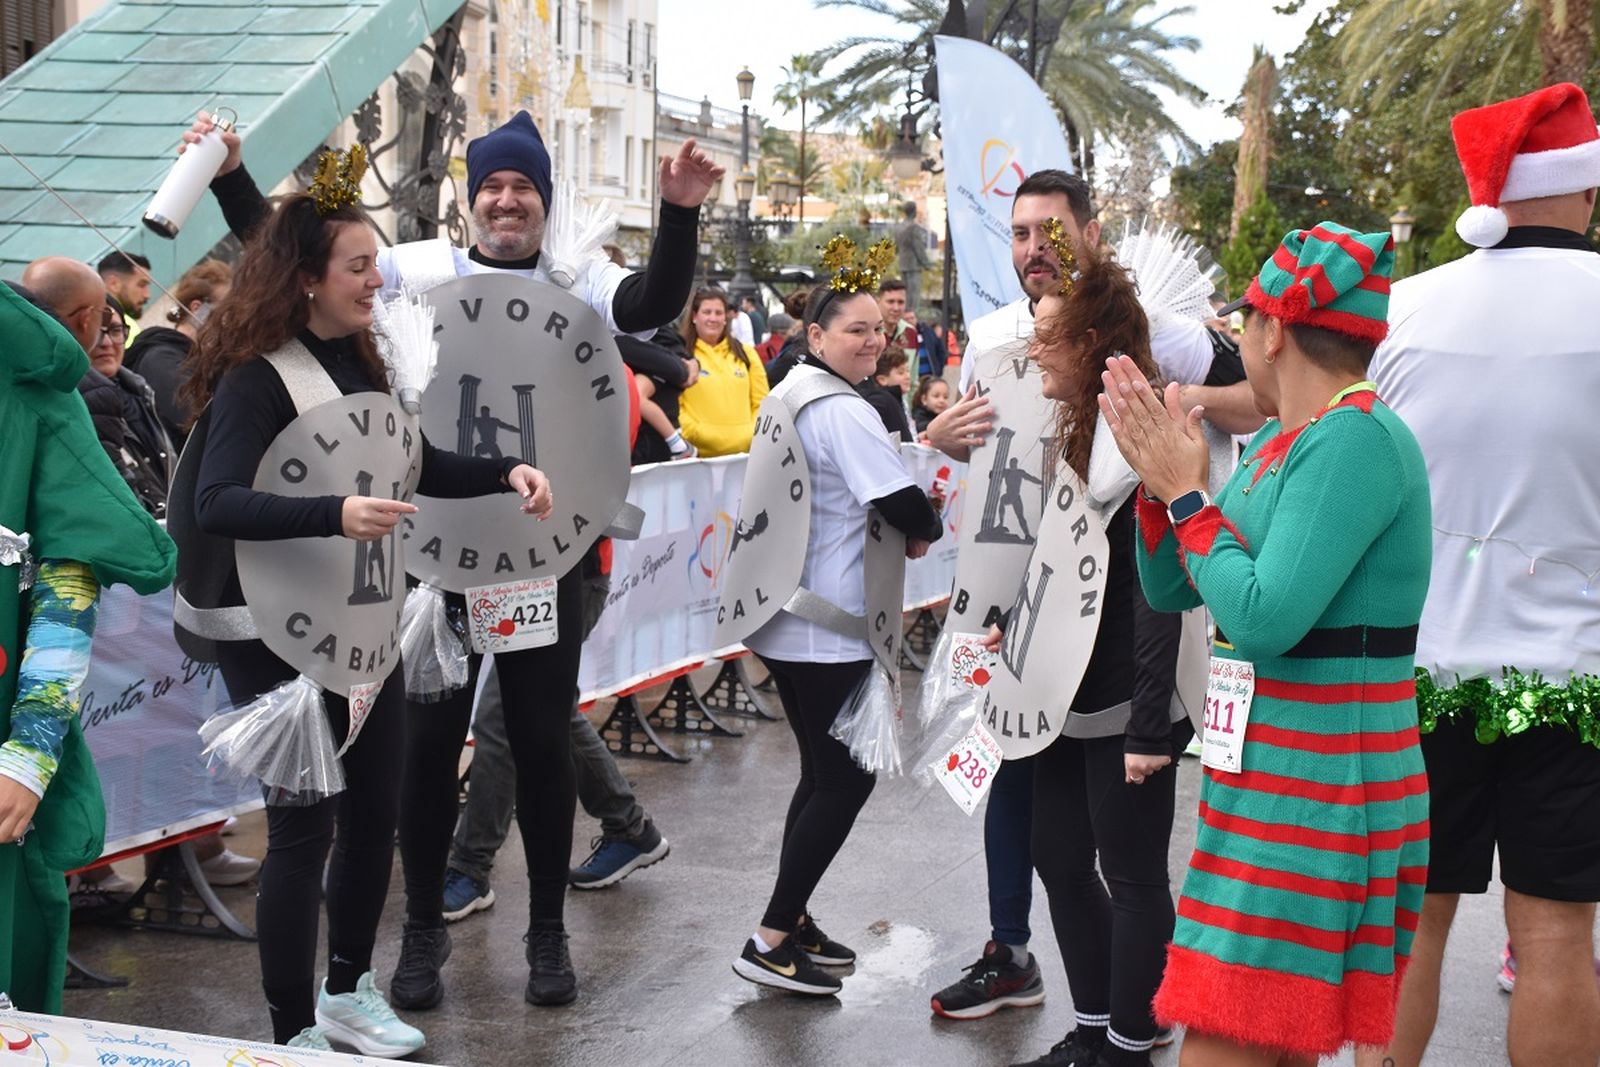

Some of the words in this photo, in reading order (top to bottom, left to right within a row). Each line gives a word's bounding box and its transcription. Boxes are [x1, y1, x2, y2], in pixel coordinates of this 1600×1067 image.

[434, 298, 615, 401] VORÓN
[1057, 485, 1103, 618] ORÓN
[512, 601, 553, 626] 422
[286, 610, 400, 672] CABALL
[152, 675, 175, 698] es
[958, 750, 987, 789] 238
